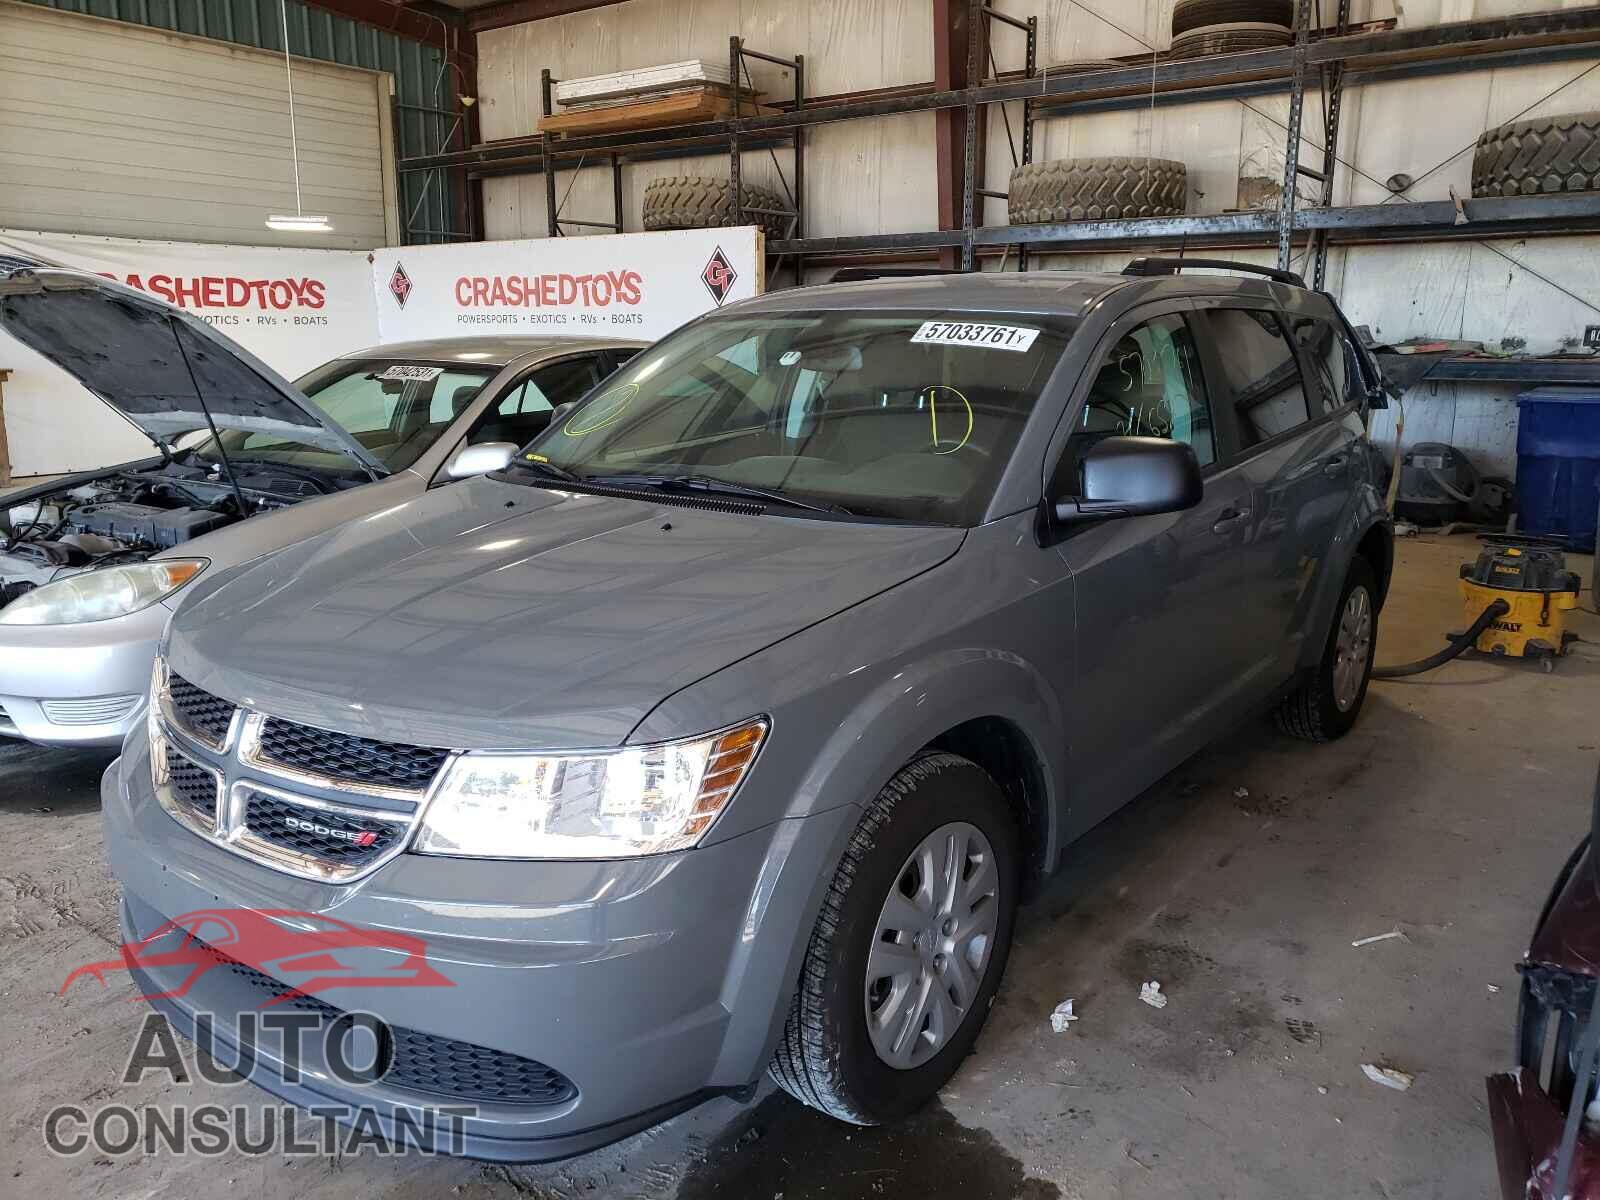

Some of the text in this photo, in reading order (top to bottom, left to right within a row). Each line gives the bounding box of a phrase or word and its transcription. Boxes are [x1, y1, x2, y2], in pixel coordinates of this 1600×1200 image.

[96, 272, 326, 310] SHEDTOYS
[455, 270, 642, 307] CRASHEDTOYS
[198, 315, 328, 325] OTICS RVs BOATS
[457, 314, 643, 324] POWERSPORTS EXOTICS RVs BOATS
[925, 323, 1018, 345] 57033761
[284, 816, 362, 843] DODGE
